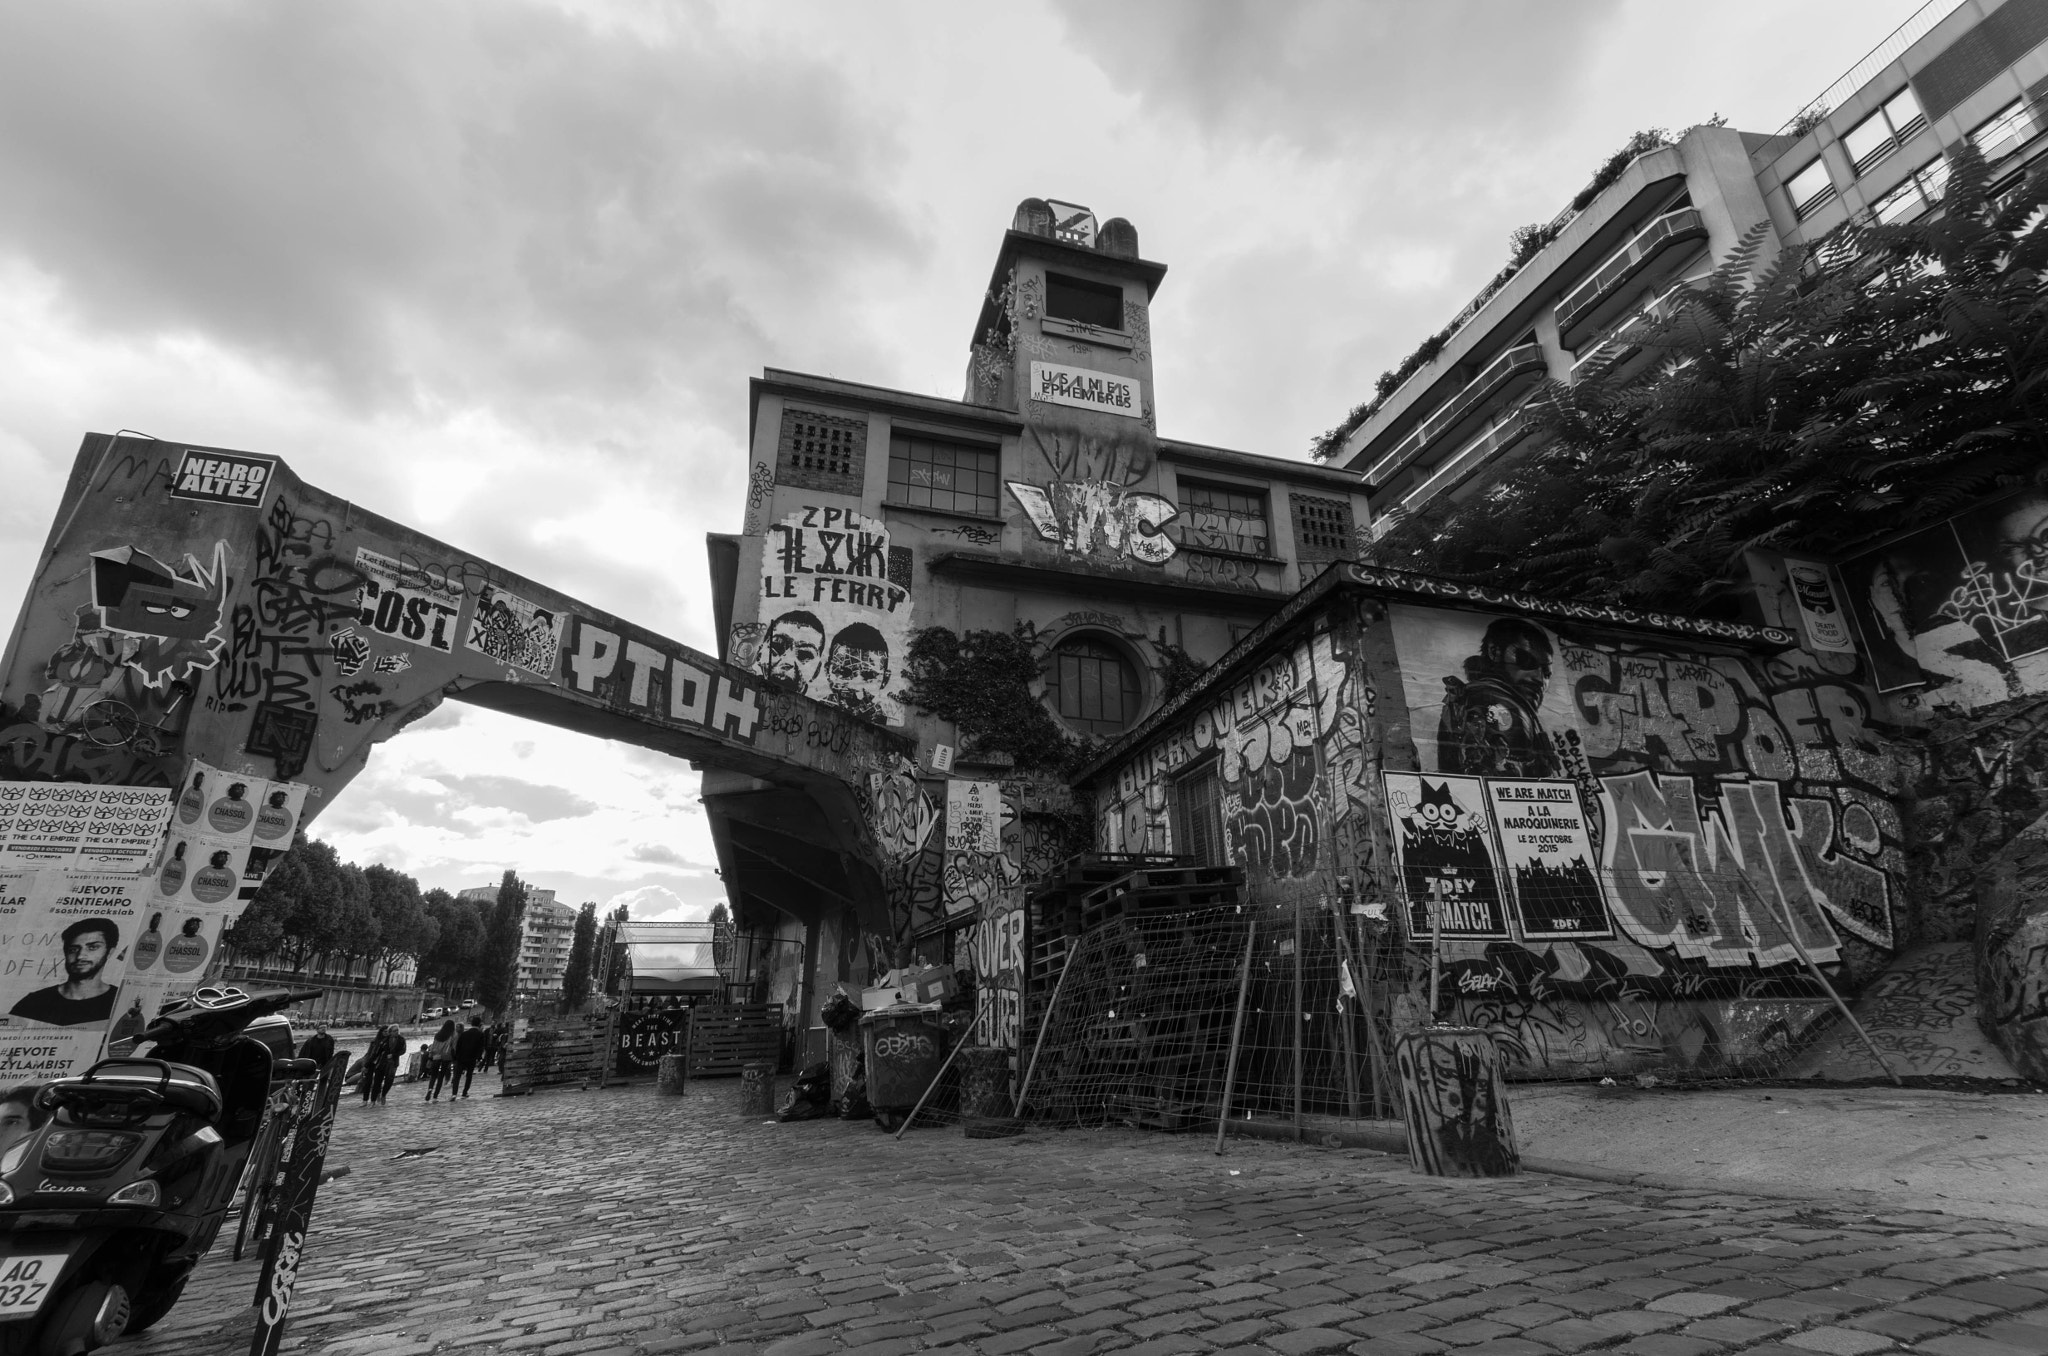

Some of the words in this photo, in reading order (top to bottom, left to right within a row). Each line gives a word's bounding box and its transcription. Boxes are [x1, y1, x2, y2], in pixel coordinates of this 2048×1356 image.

[1042, 370, 1130, 396] USINES
[1042, 382, 1131, 408] EPHEMERES
[185, 457, 266, 483] NEARO
[179, 475, 261, 499] ALTEZ
[362, 553, 378, 566] Let
[378, 559, 400, 573] them
[356, 560, 370, 572] It's
[370, 566, 385, 579] not
[421, 587, 432, 597] my
[765, 576, 797, 598] LE
[814, 577, 905, 613] FERRY
[357, 580, 457, 650] COST
[1496, 787, 1512, 799] WE
[1515, 788, 1534, 799] ARE
[1537, 788, 1572, 800] MATCH
[214, 807, 246, 820] CHASSOL
[1528, 806, 1535, 816] A
[1537, 806, 1551, 817] LA
[1504, 817, 1580, 829] MAROQUINERIE
[1518, 835, 1527, 843] LE
[1529, 835, 1538, 843] 21
[1539, 835, 1573, 843] OCTOBRE
[1538, 844, 1558, 853] 2015
[198, 876, 229, 887] CHASSOL
[1425, 876, 1476, 894] ZDEY
[72, 886, 125, 895] #JEVOTE
[56, 896, 132, 907] #SINTIEMPO
[1440, 902, 1492, 930] MATCH
[1552, 919, 1580, 929] ZDEY
[169, 946, 200, 956] CHASSOL
[978, 908, 1025, 978] OVER
[978, 988, 1020, 1048] BURA
[622, 1031, 681, 1048] BEAST
[35, 1178, 88, 1193] Vespa
[1, 1260, 43, 1282] AQ
